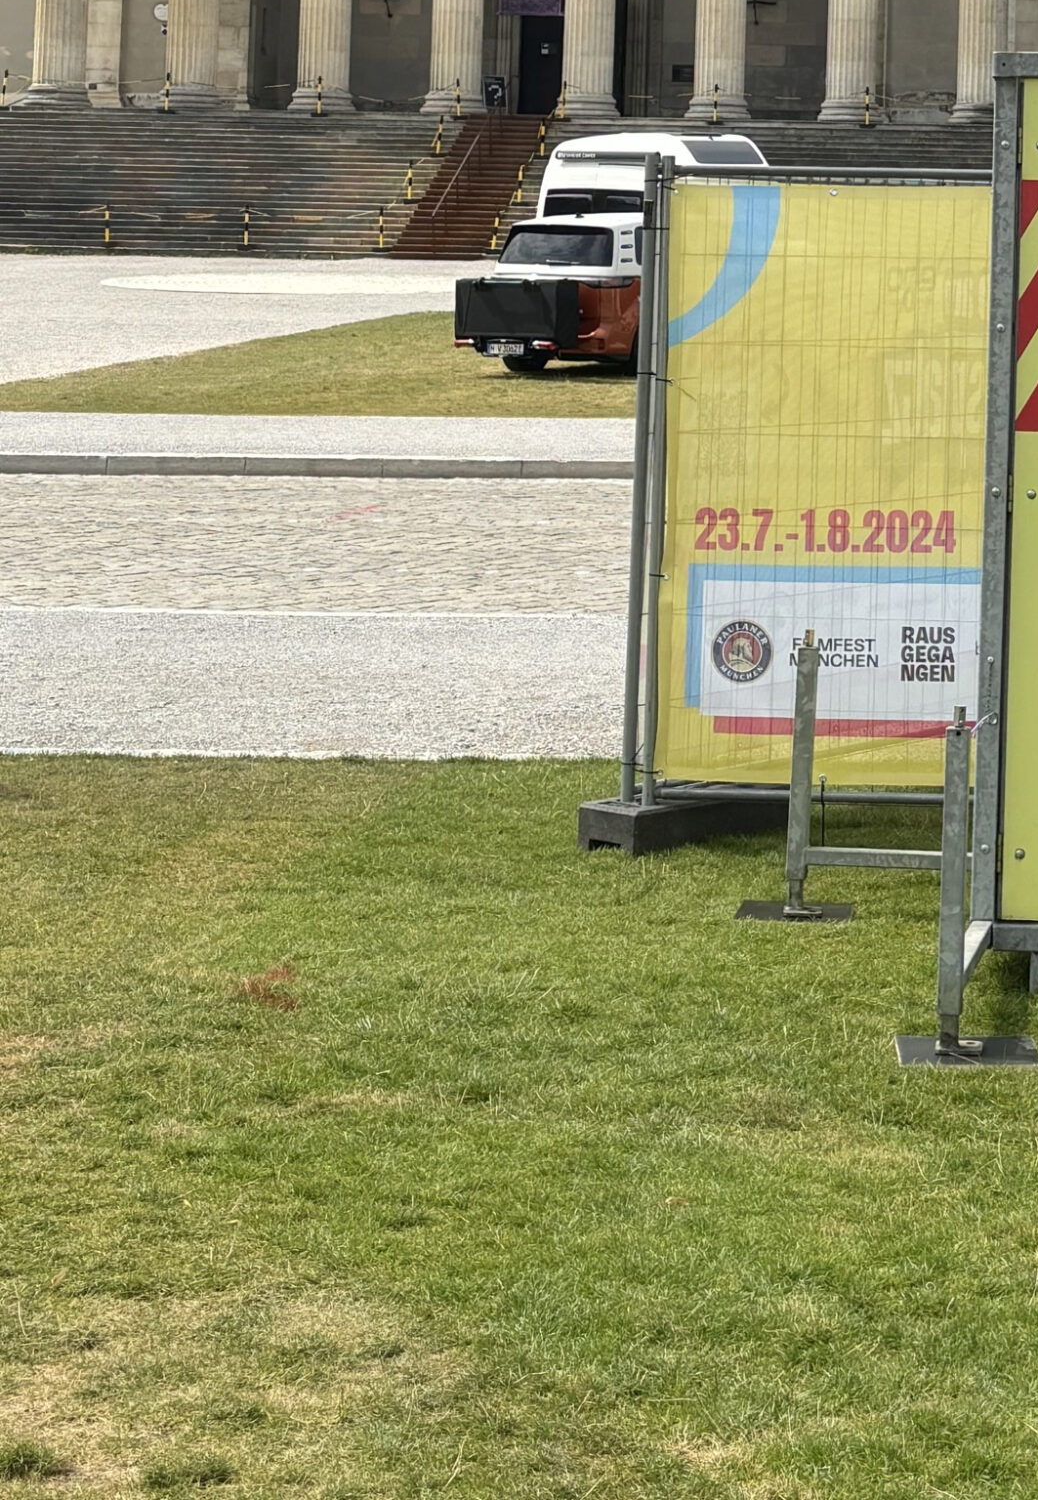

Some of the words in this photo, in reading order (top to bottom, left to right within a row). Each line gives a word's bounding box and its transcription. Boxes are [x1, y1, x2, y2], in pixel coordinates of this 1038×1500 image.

[716, 622, 768, 646] PAULANER
[901, 626, 956, 644] RAUS
[793, 637, 876, 652] FMFEST
[789, 653, 879, 668] MNCHEN
[901, 645, 955, 663] GEGA
[901, 664, 955, 682] NGEN
